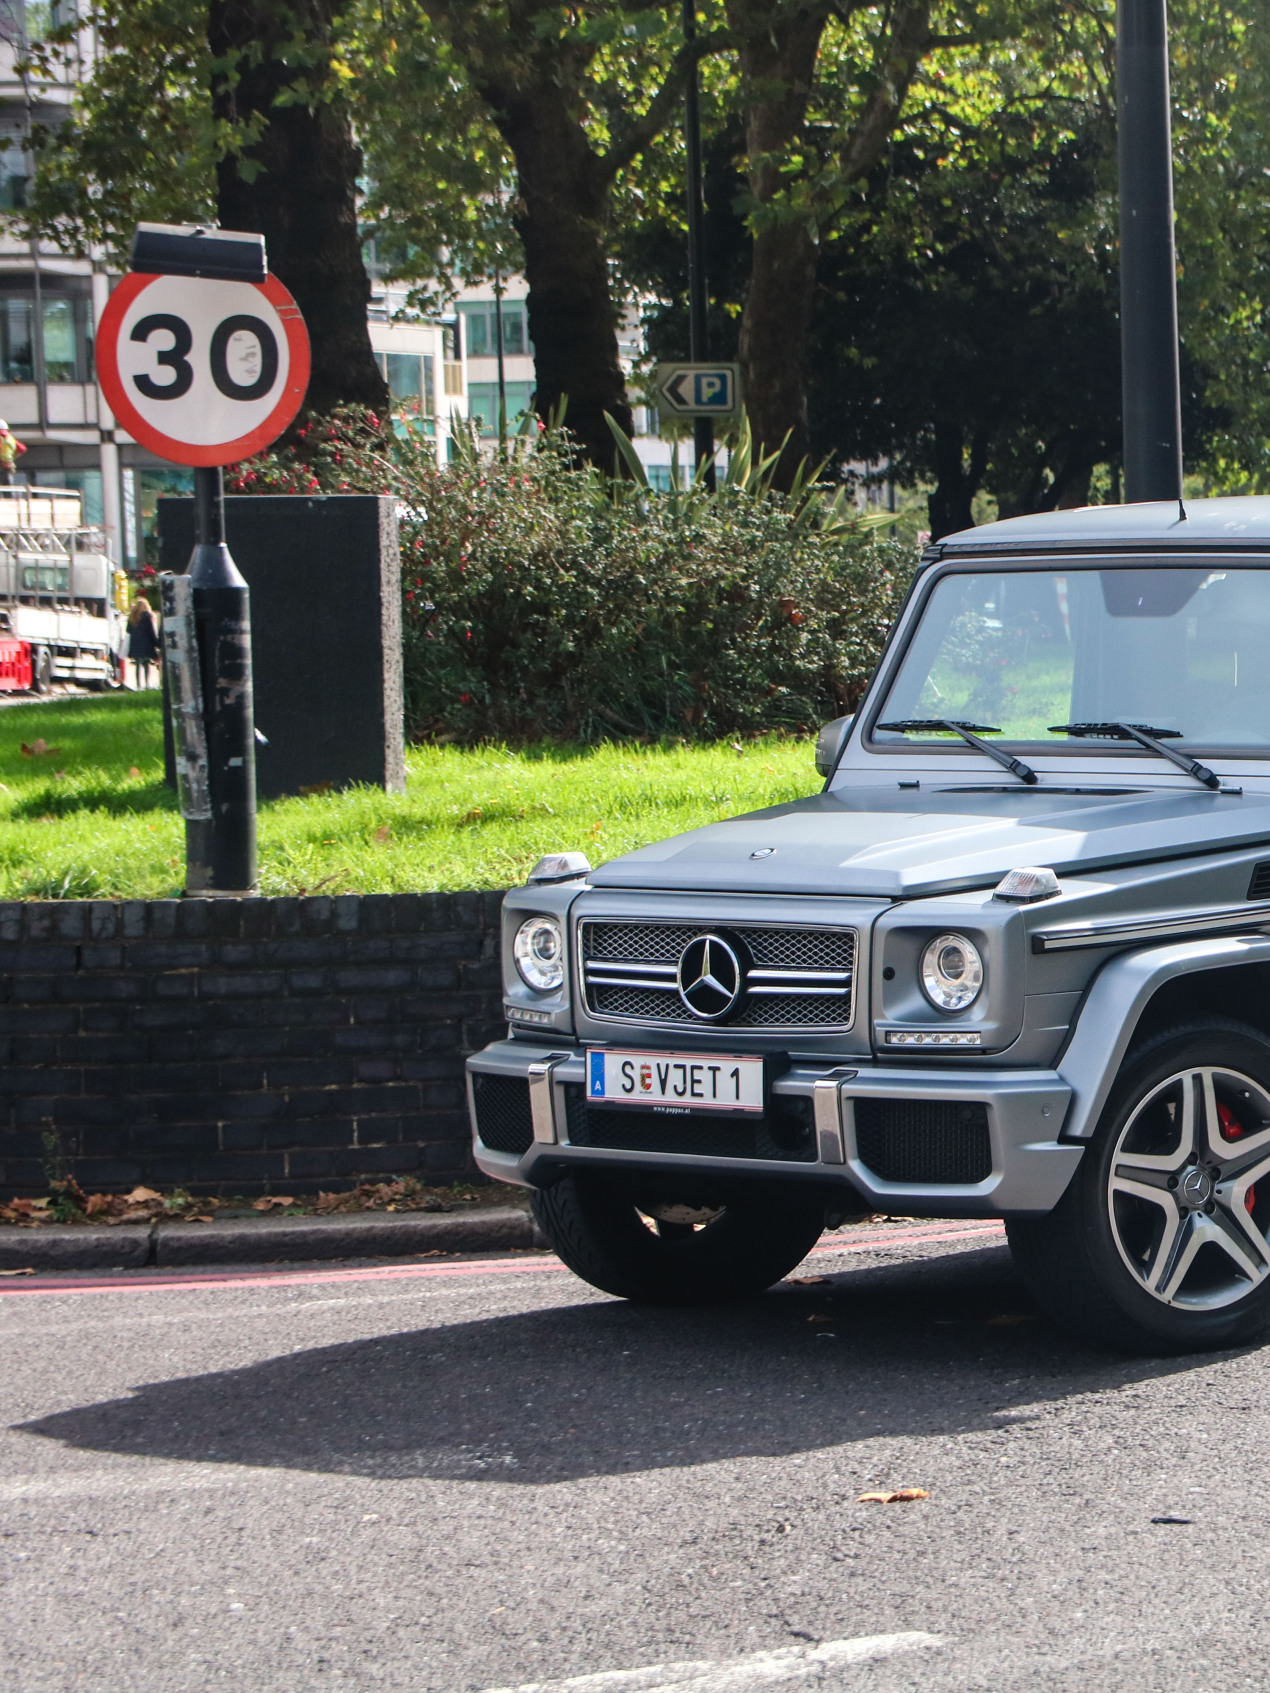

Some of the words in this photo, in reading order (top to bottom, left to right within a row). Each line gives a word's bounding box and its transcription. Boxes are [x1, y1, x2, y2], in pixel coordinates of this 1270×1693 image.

[130, 313, 279, 402] 30
[701, 376, 721, 403] P
[594, 1080, 602, 1091] A
